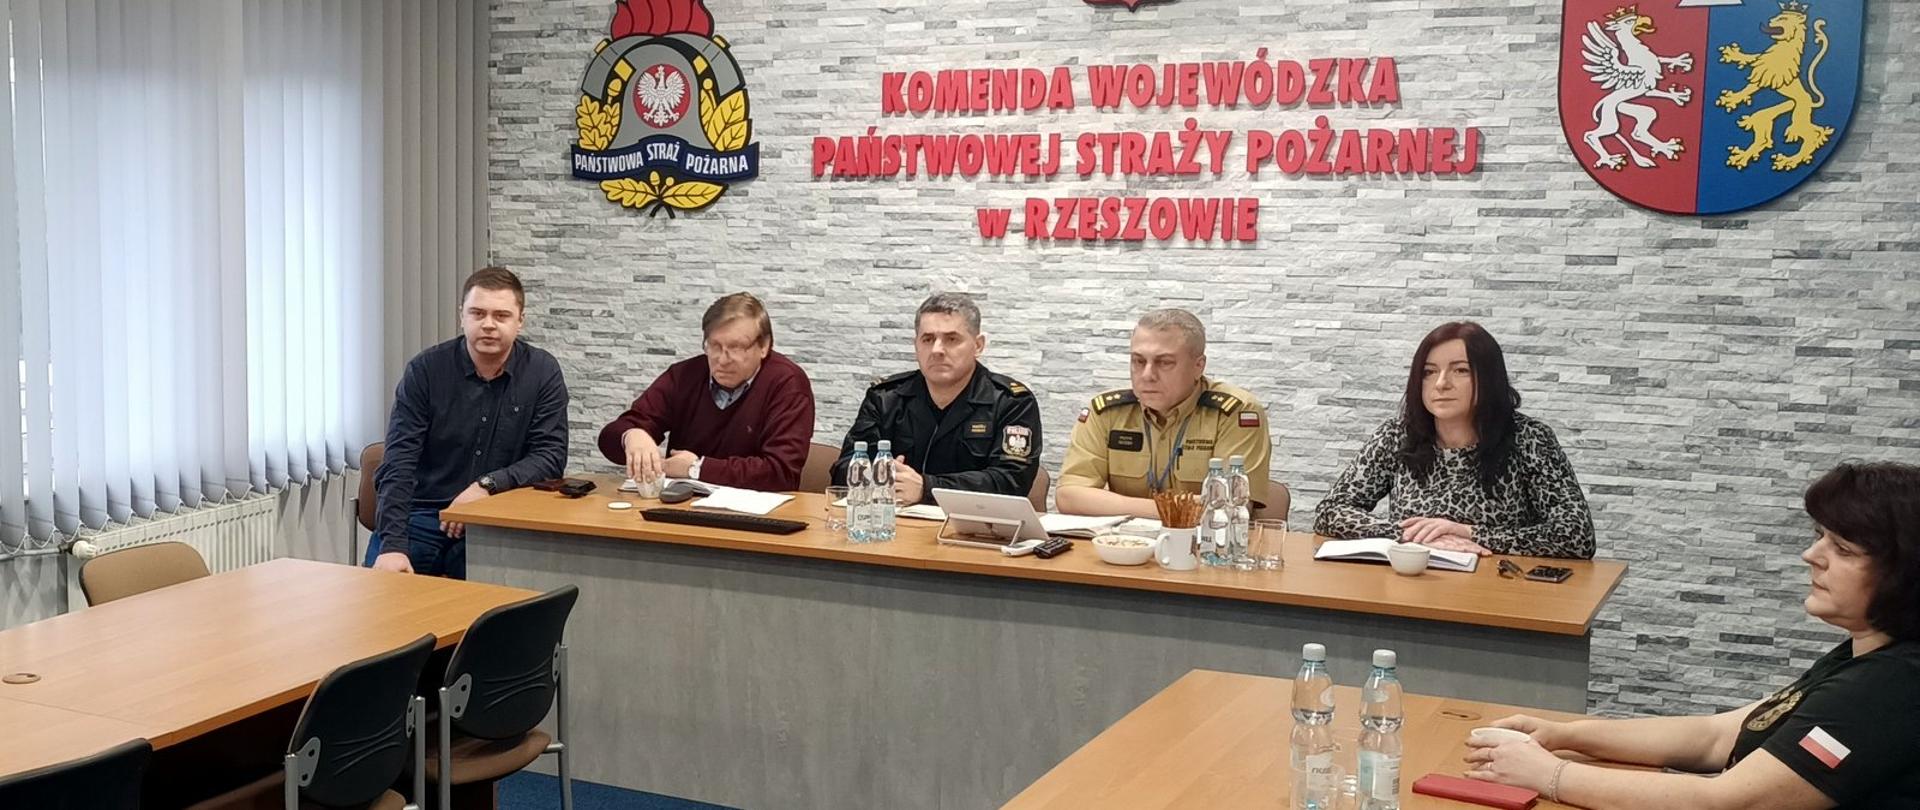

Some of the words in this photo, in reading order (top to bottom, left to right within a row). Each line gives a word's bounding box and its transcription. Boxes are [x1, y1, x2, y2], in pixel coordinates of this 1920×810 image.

[881, 67, 1075, 114] KOMENDA
[1088, 48, 1398, 110] WOJEWÓDZKA
[575, 152, 644, 173] PAŃSTWOWA
[646, 142, 680, 162] STRAŻ
[686, 153, 749, 175] POŻARNA
[813, 127, 1061, 177] PAŃSTWOWEJ
[1076, 118, 1232, 177] STRAŻY
[1247, 116, 1479, 175] POŻARNEJ
[977, 208, 1012, 239] w
[1024, 197, 1260, 241] RZESZOWIE
